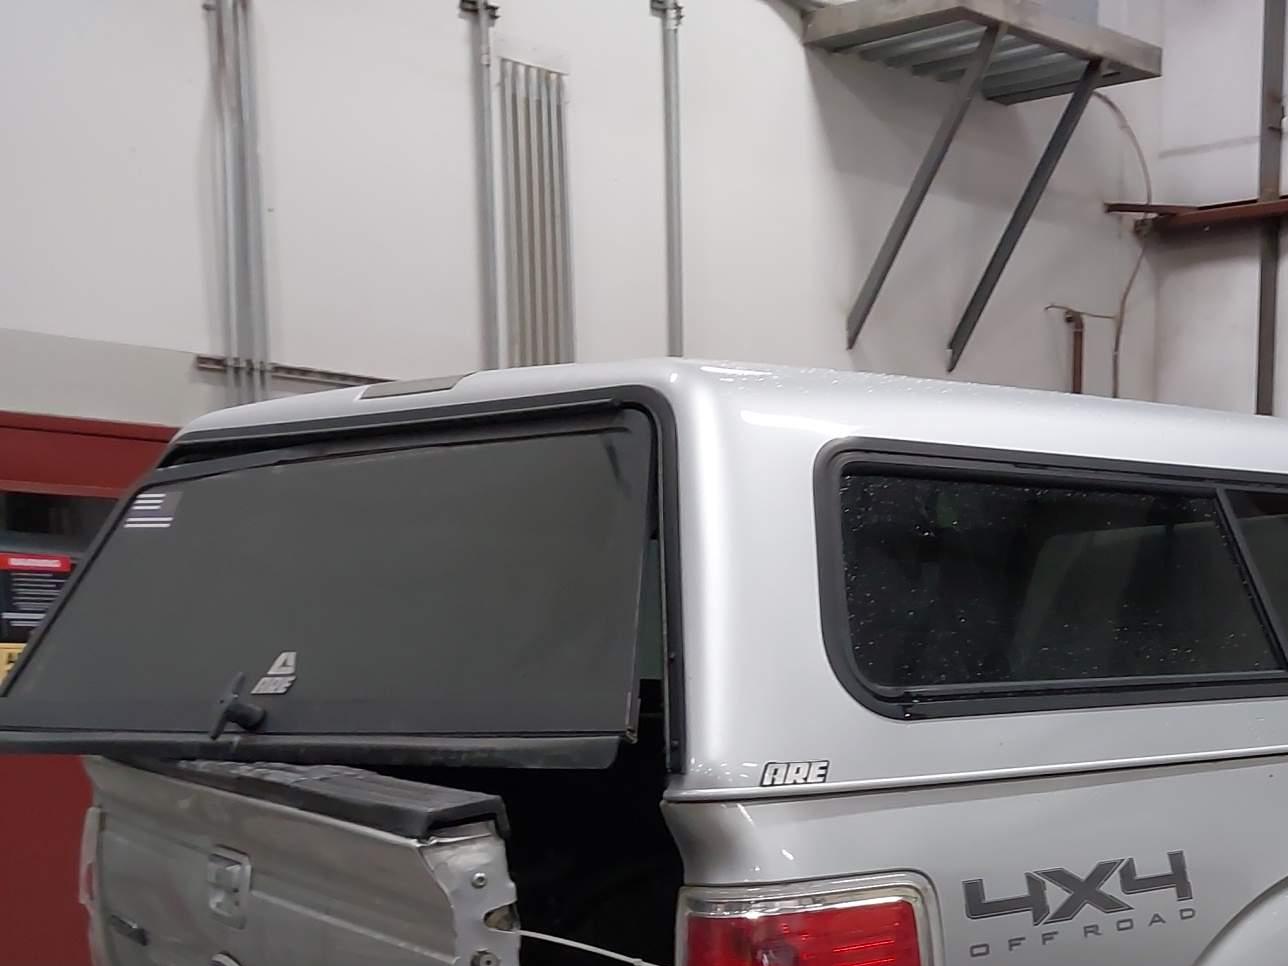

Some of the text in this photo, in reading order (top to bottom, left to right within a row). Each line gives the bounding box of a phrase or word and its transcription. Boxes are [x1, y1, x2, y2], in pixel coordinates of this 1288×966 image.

[760, 760, 829, 787] ARE
[962, 850, 1193, 926] 4X4
[969, 908, 1197, 958] OFF ROAD
